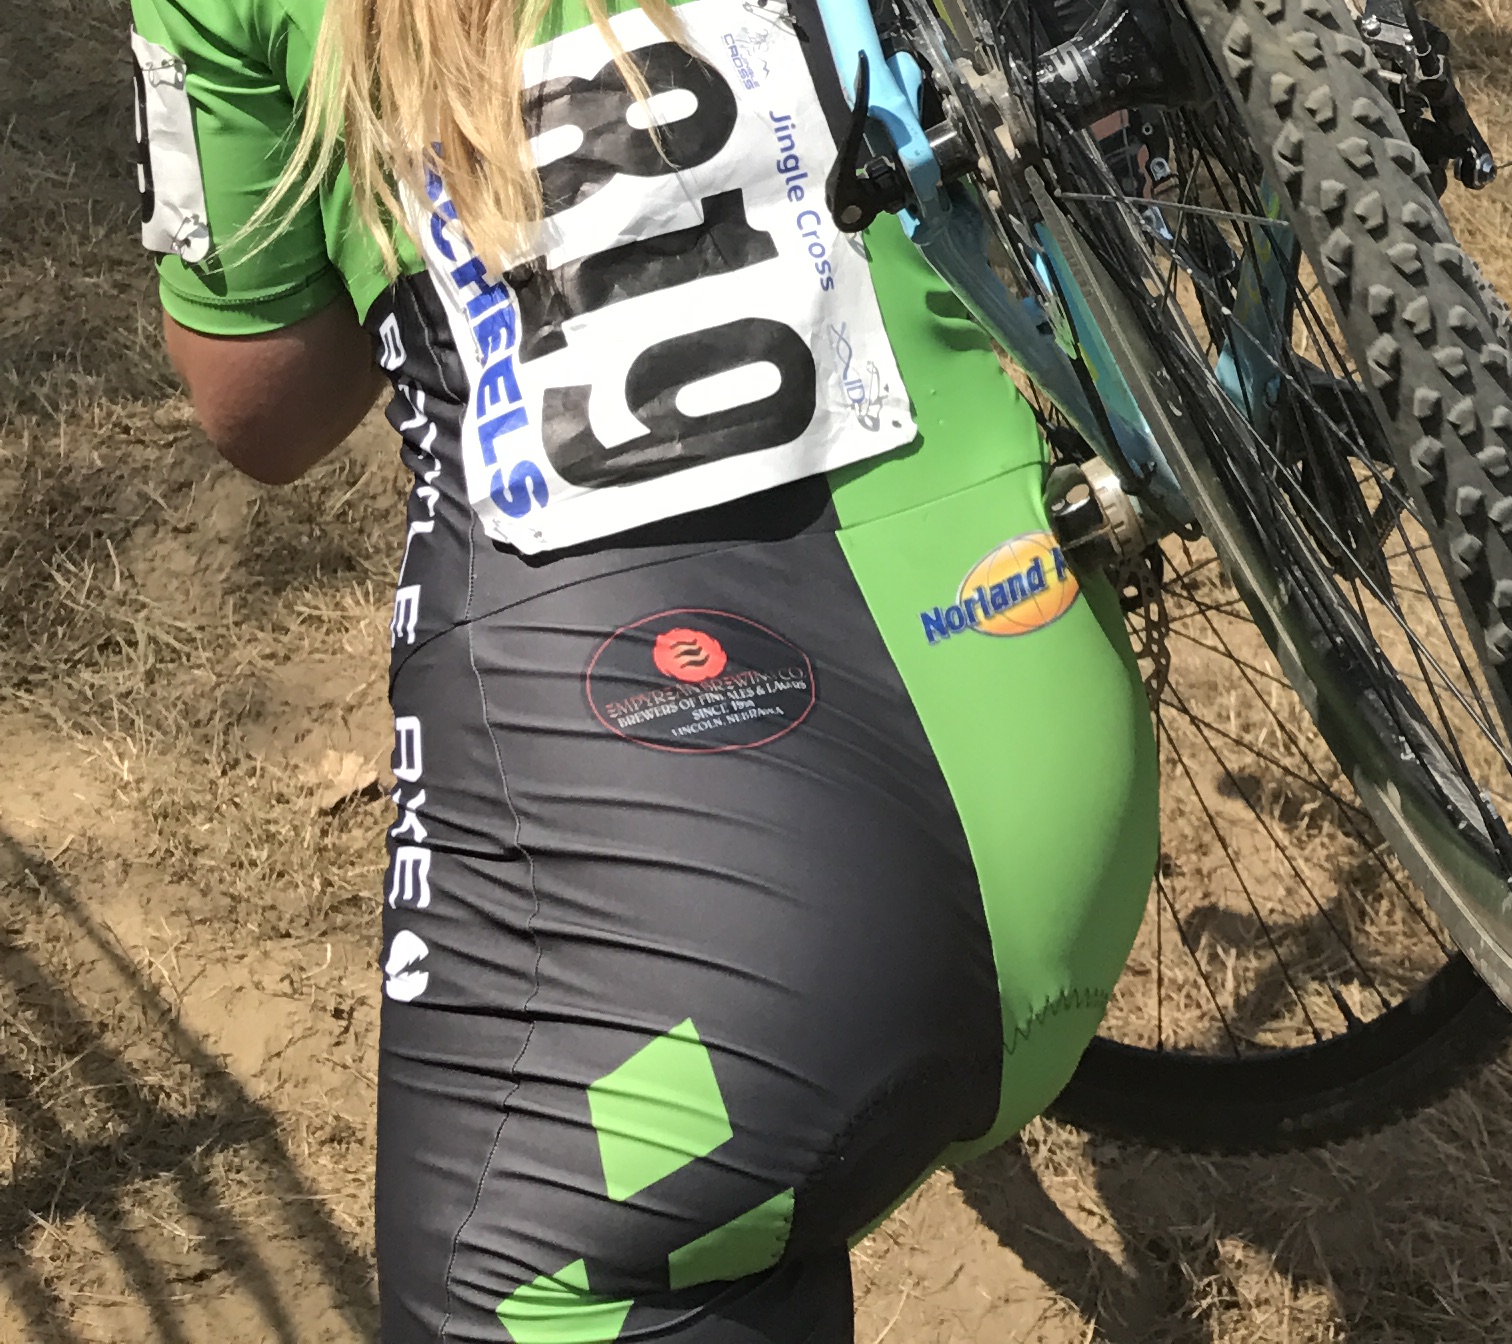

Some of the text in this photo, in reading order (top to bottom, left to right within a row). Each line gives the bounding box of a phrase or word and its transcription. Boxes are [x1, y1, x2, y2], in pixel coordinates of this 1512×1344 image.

[769, 109, 835, 292] Jingle Cross
[504, 41, 817, 489] 819
[920, 557, 1048, 645] Norland
[617, 702, 678, 728] BREWERS
[692, 702, 730, 722] SINCE
